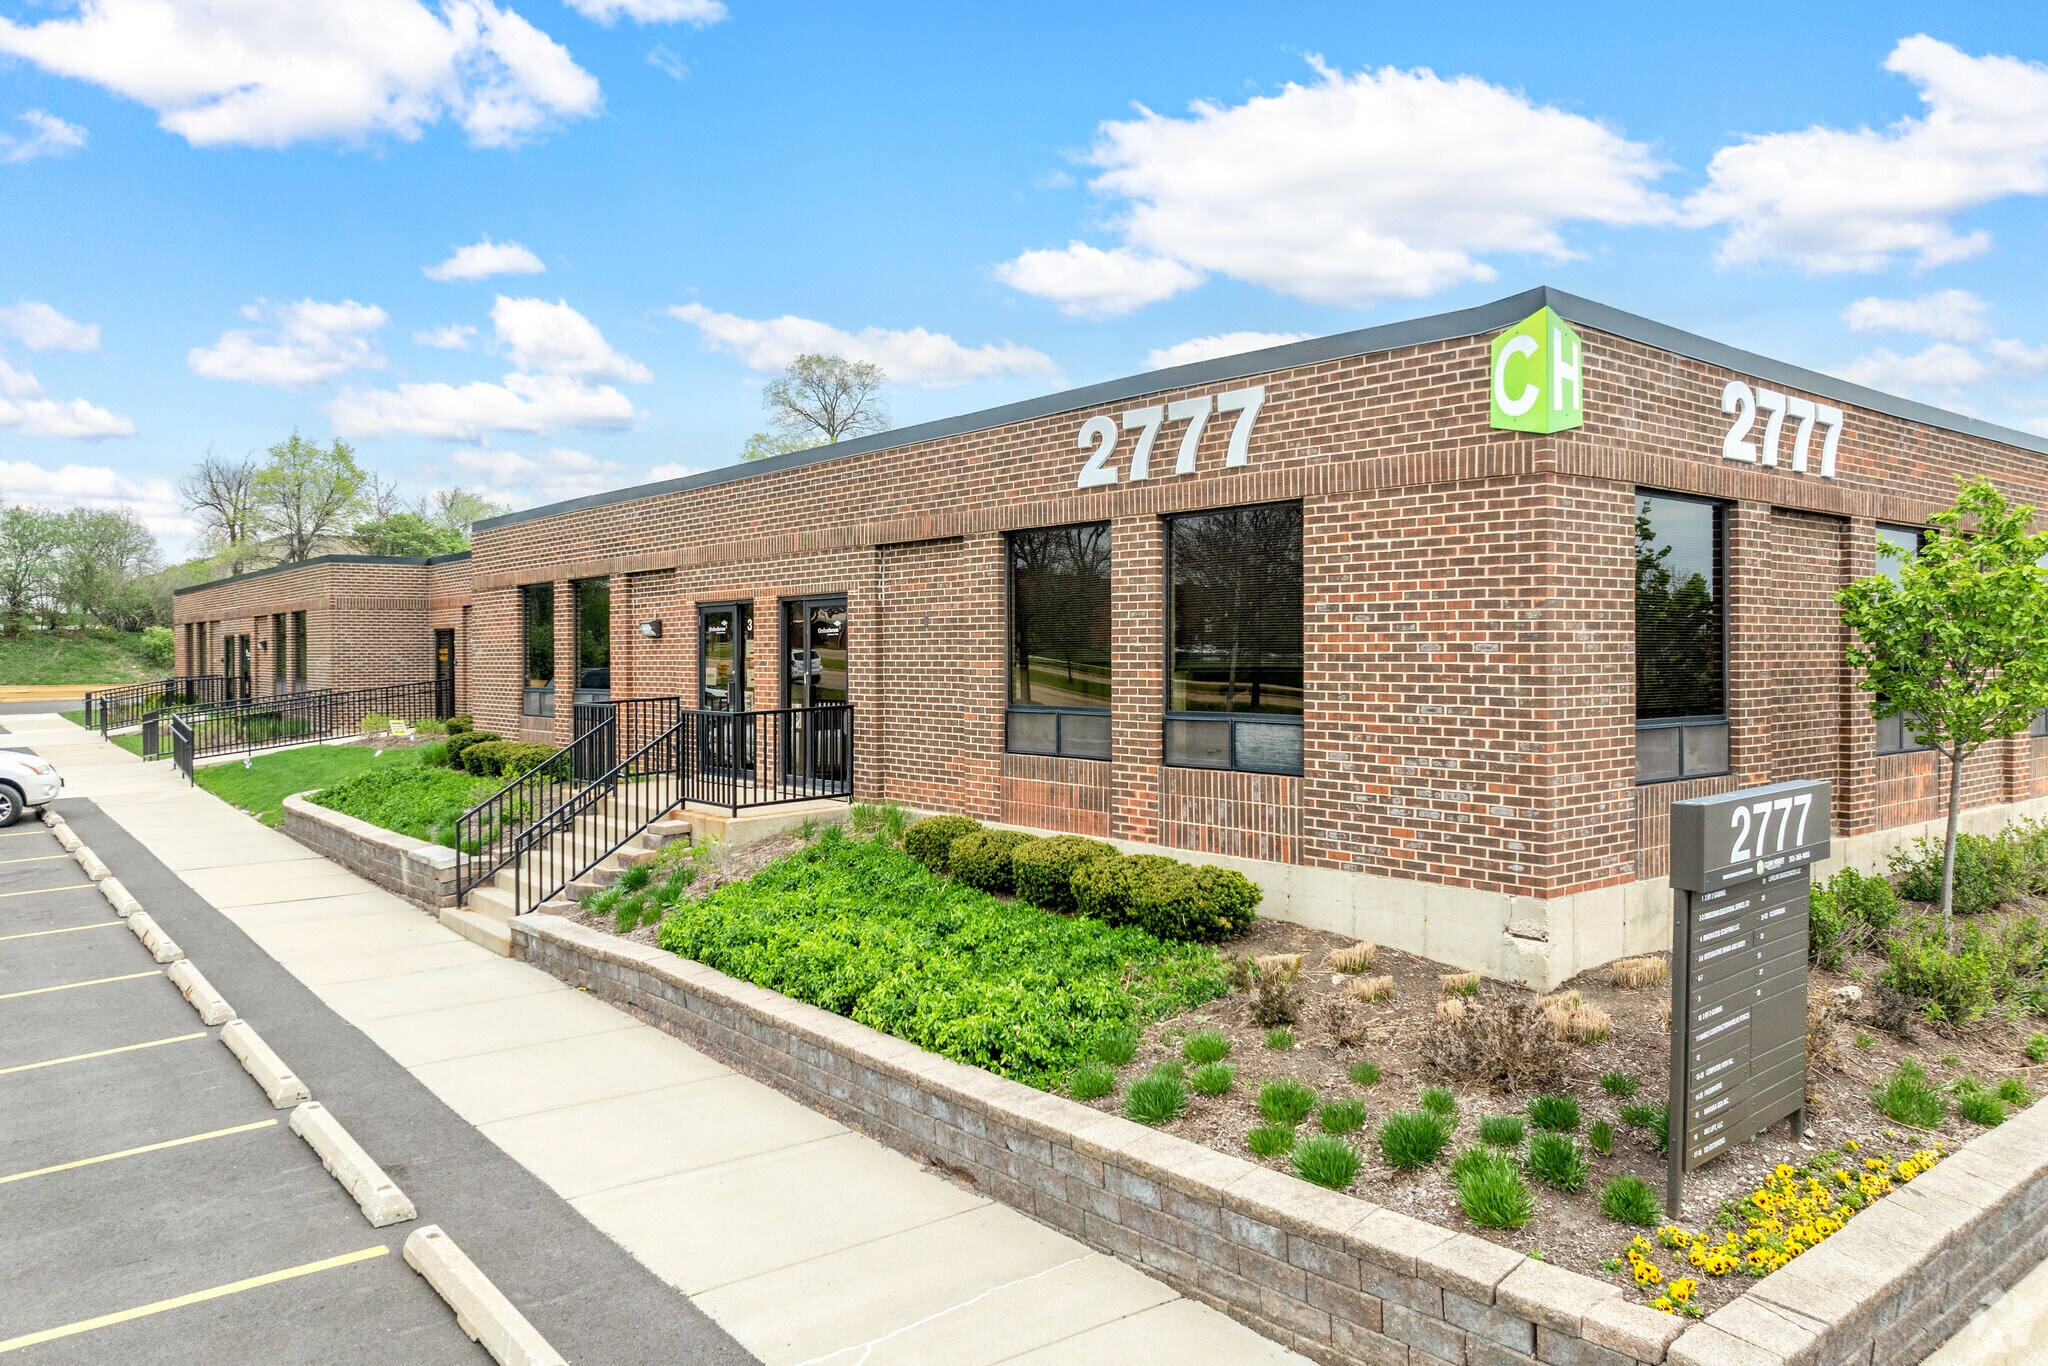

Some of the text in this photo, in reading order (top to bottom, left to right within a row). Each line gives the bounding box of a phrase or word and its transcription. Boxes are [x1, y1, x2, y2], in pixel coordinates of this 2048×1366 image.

[1078, 385, 1266, 489] 2777
[1722, 380, 1844, 479] 2777
[747, 618, 753, 631] 3
[1730, 793, 1812, 864] 2777
